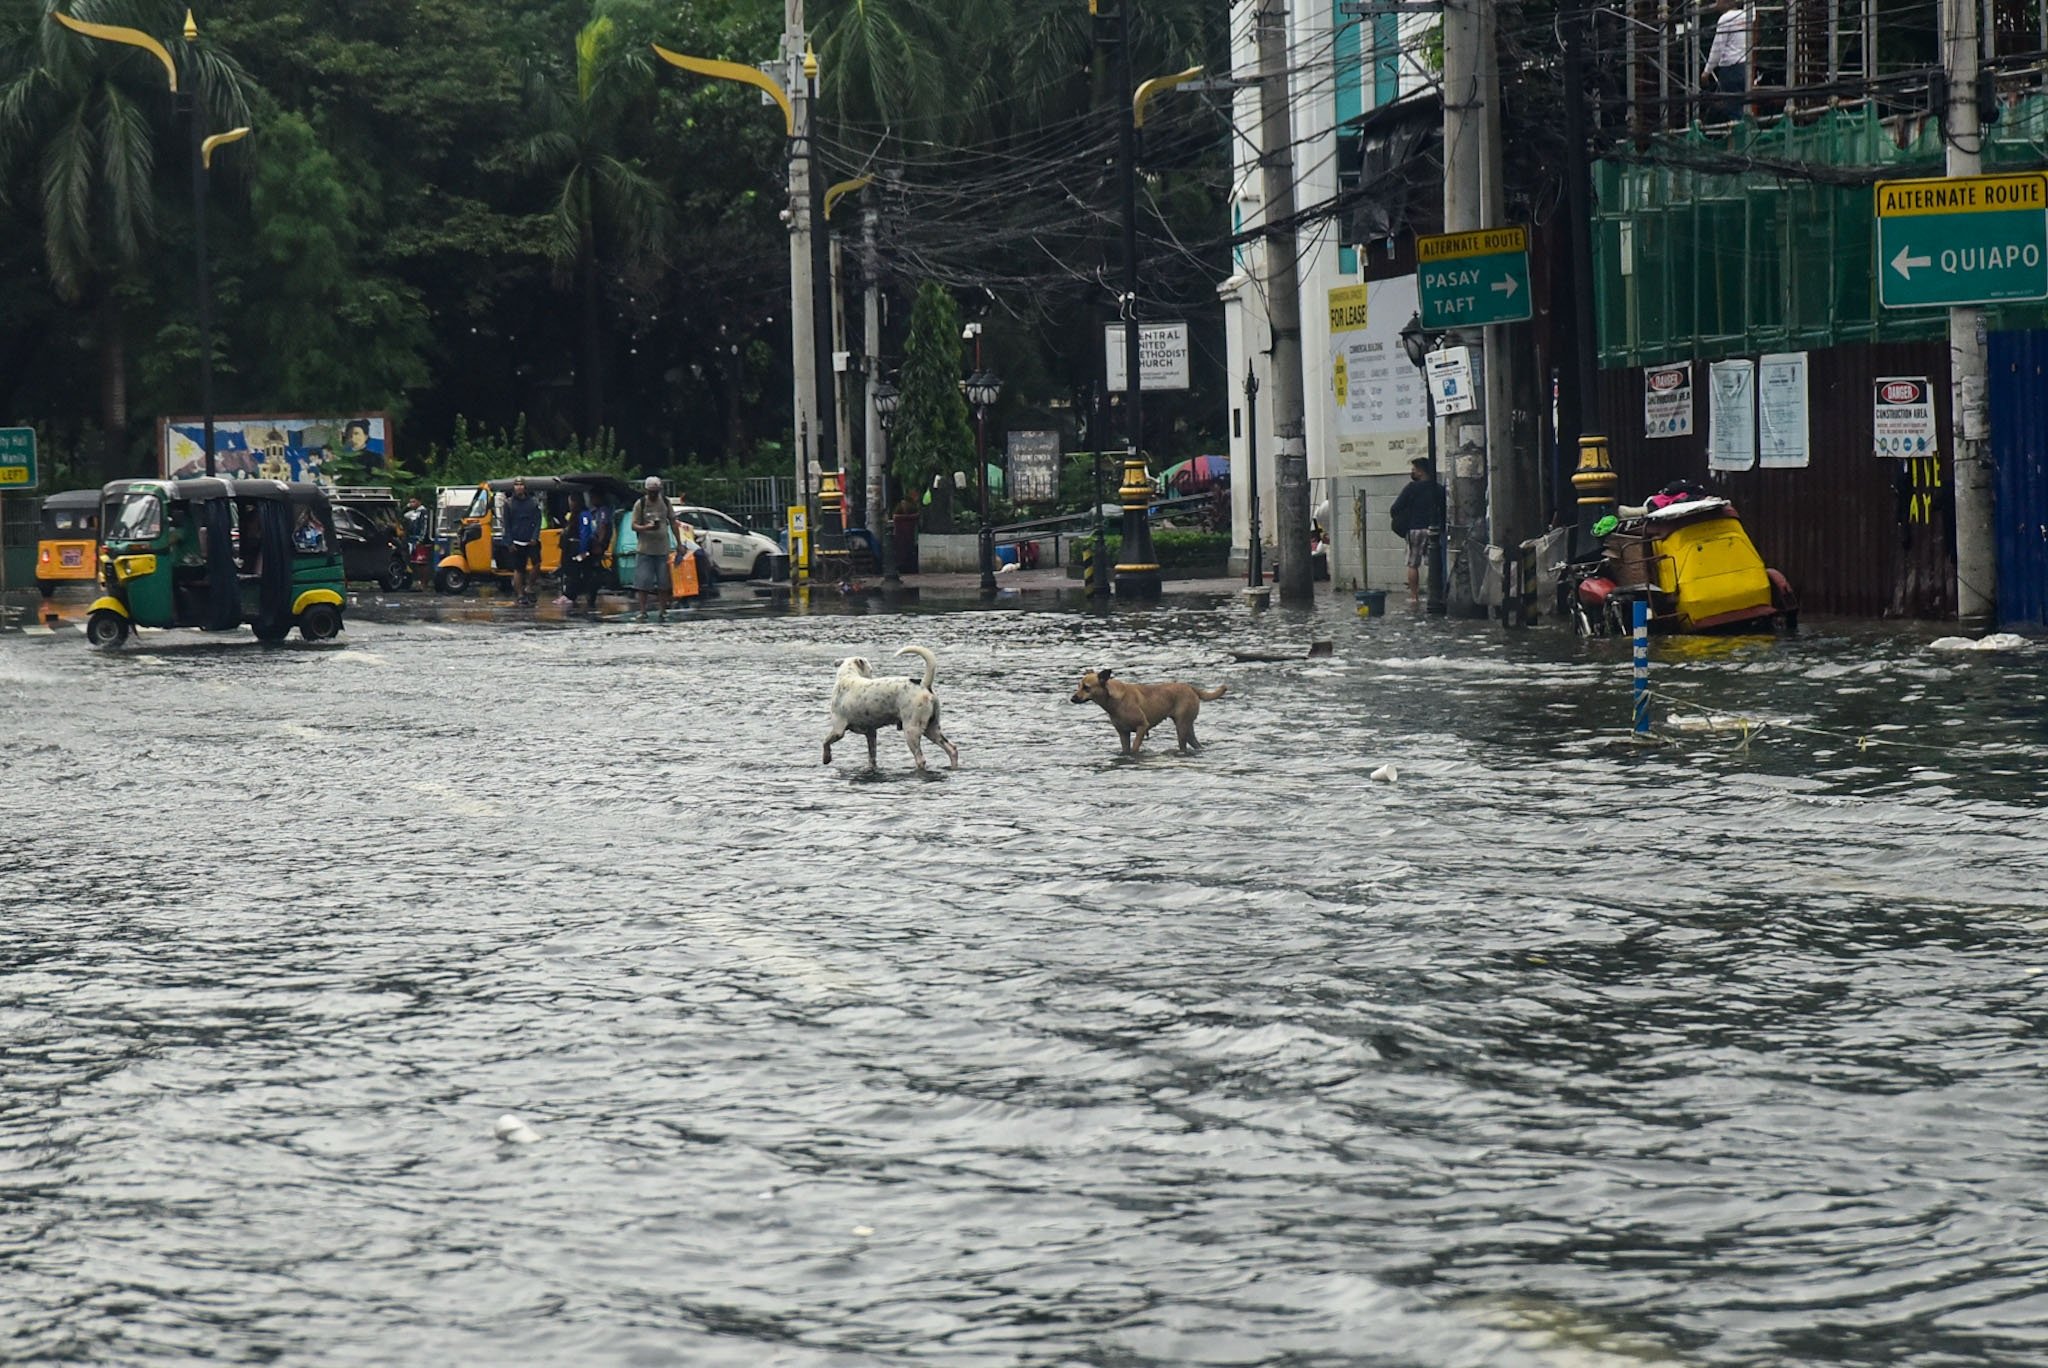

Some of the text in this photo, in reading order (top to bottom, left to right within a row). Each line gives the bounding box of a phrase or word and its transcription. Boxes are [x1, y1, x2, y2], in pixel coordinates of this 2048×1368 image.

[1886, 183, 2039, 211] ALTERNATE ROUTE
[1423, 231, 1521, 257] ALTERNATE ROUTE
[1940, 243, 2040, 274] QUIAPO
[1425, 269, 1480, 289] PASAY
[1434, 296, 1476, 315] TAFT
[1331, 304, 1366, 327] FOR LEASE
[1139, 330, 1181, 341] ENTRAL
[1139, 341, 1166, 349] NITED
[1139, 349, 1186, 359] ETHODIST
[1139, 359, 1173, 368] HURCH
[1887, 385, 1913, 400] DANGER
[1876, 407, 1928, 419] CONSTRUCTION AREA
